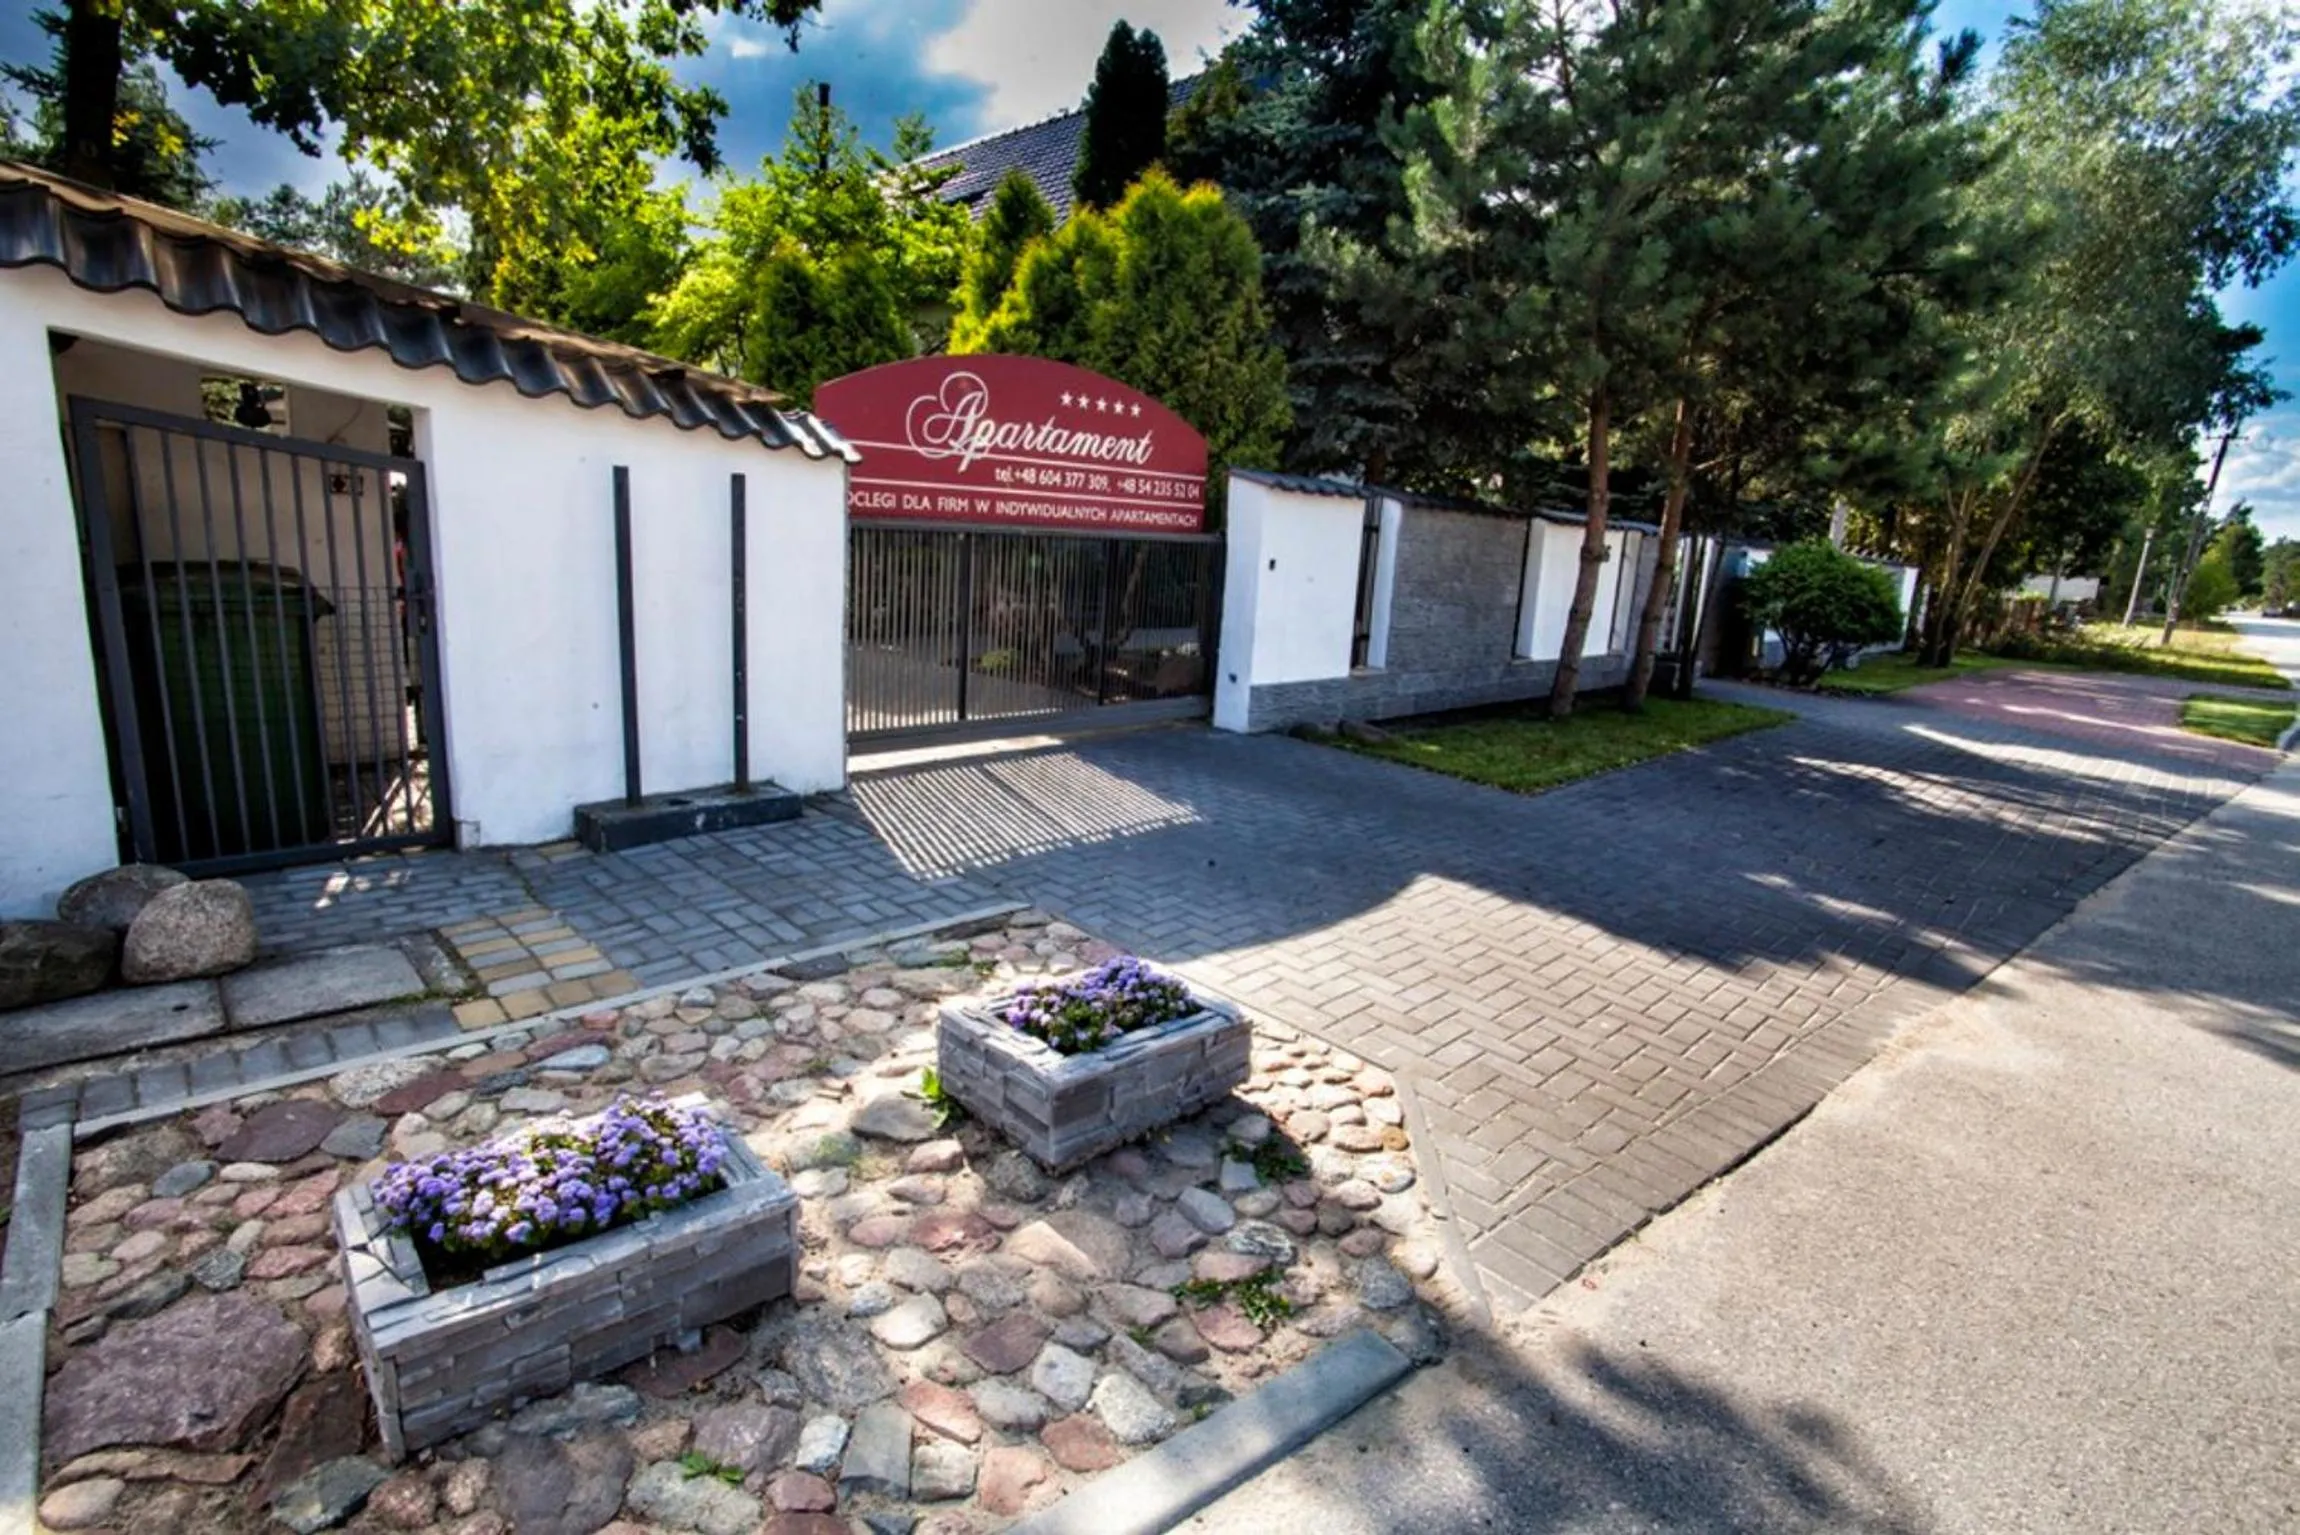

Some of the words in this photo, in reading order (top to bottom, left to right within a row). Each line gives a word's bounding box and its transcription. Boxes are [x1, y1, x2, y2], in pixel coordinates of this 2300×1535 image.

[906, 371, 1153, 473] Apartament
[1039, 468, 1061, 486] 604
[1063, 471, 1085, 488] 377
[1117, 478, 1136, 493] +48
[1138, 479, 1151, 494] 54
[1153, 480, 1172, 496] 235
[1187, 483, 1200, 499] 04
[903, 494, 931, 511] DLA
[938, 496, 968, 513] FIRM
[975, 499, 990, 513] W
[996, 501, 1107, 520] INDYWIDUALNYCH
[1110, 508, 1198, 527] APARTAMENTACH
